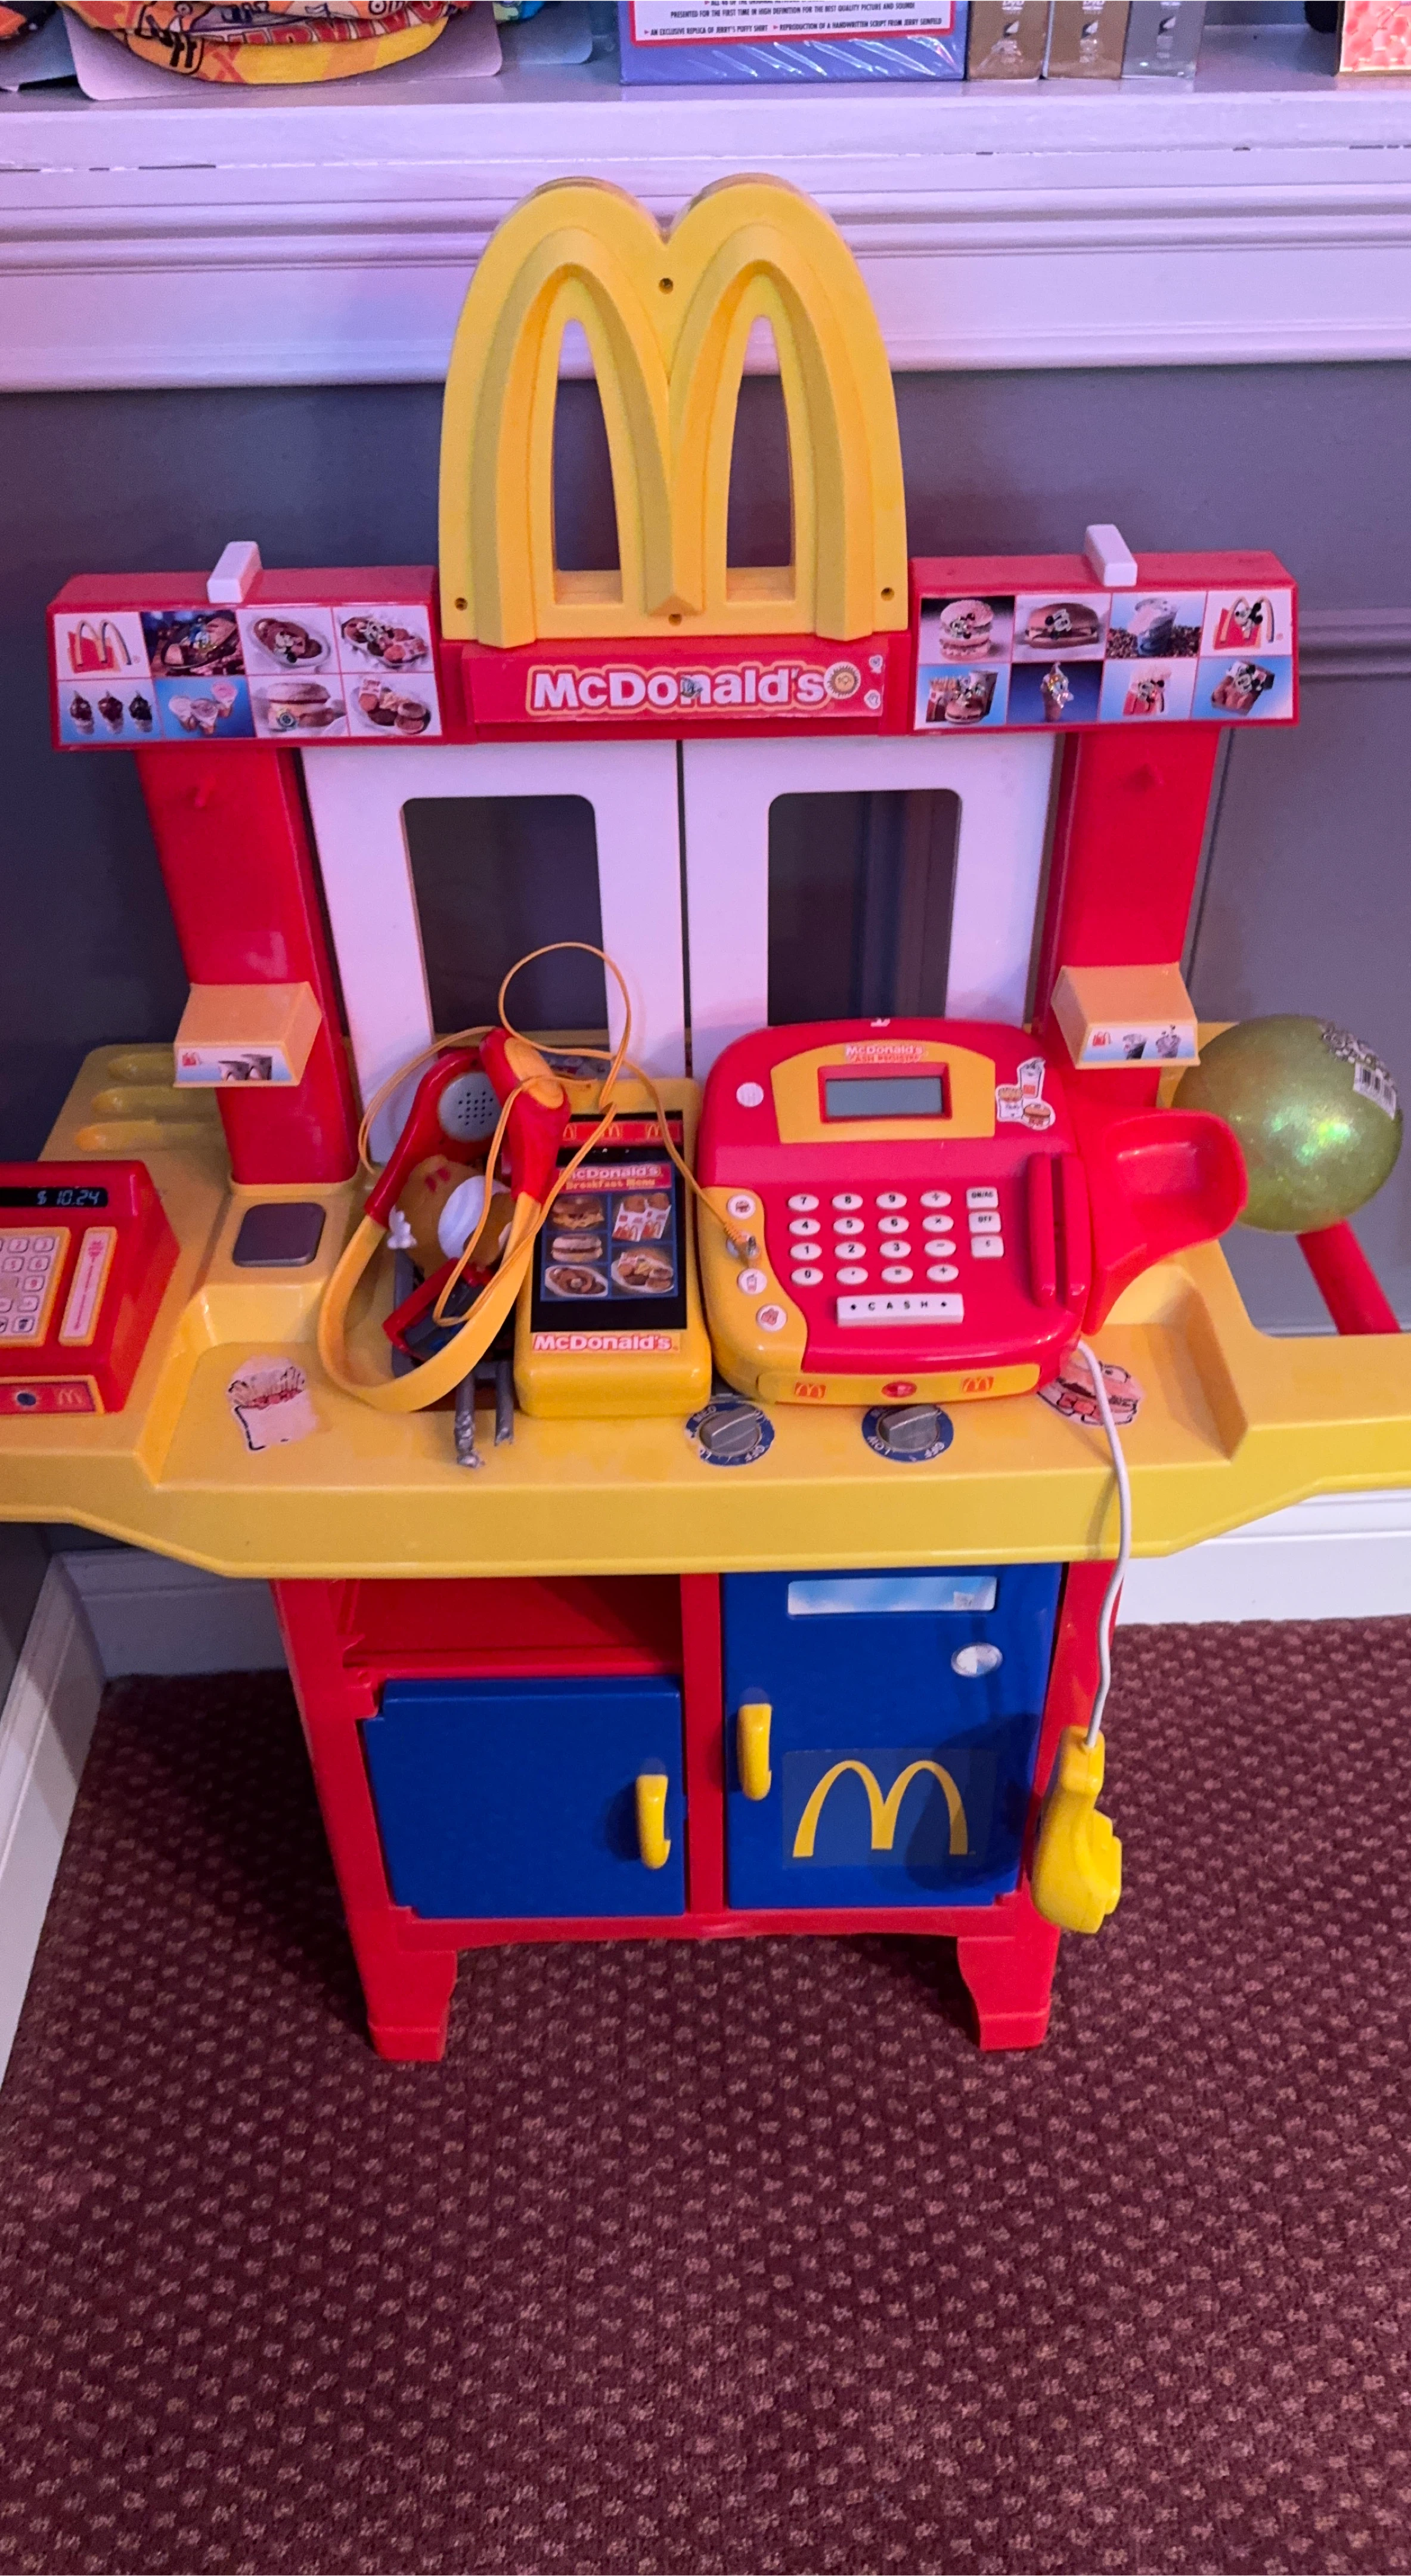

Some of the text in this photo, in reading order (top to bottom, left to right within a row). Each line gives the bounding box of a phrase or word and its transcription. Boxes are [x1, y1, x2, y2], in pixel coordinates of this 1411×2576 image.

[534, 667, 826, 708] McDonald's
[846, 1045, 923, 1055] McDonald's
[572, 1164, 660, 1179] cDonald's
[57, 1190, 100, 1205] 10.24
[801, 1196, 807, 1205] 7
[845, 1196, 851, 1204] 8
[889, 1194, 895, 1203] 9
[846, 1219, 852, 1228] 5
[891, 1218, 898, 1227] 6
[805, 1246, 809, 1254] 1
[848, 1244, 855, 1253] 2
[894, 1243, 900, 1252] 3
[805, 1270, 811, 1278] 0
[868, 1301, 928, 1311] CASH
[536, 1335, 671, 1350] McDonald's
